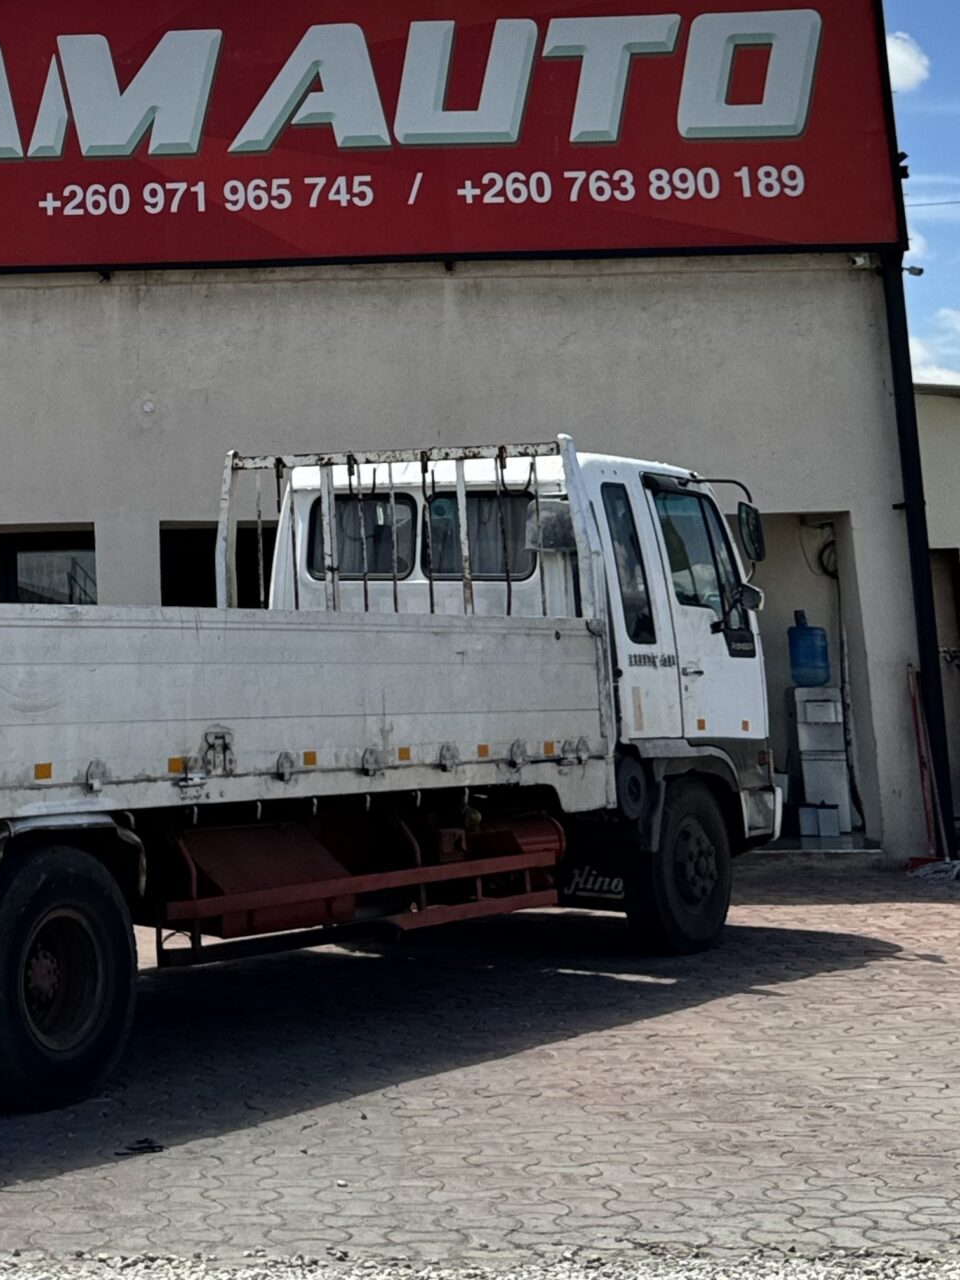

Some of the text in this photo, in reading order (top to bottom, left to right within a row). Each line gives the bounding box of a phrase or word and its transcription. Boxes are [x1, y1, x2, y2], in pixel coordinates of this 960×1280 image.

[227, 8, 822, 153] AUTO
[38, 164, 805, 217] +260 971 965 745 / +260 763 890 189
[564, 865, 624, 895] Hino
